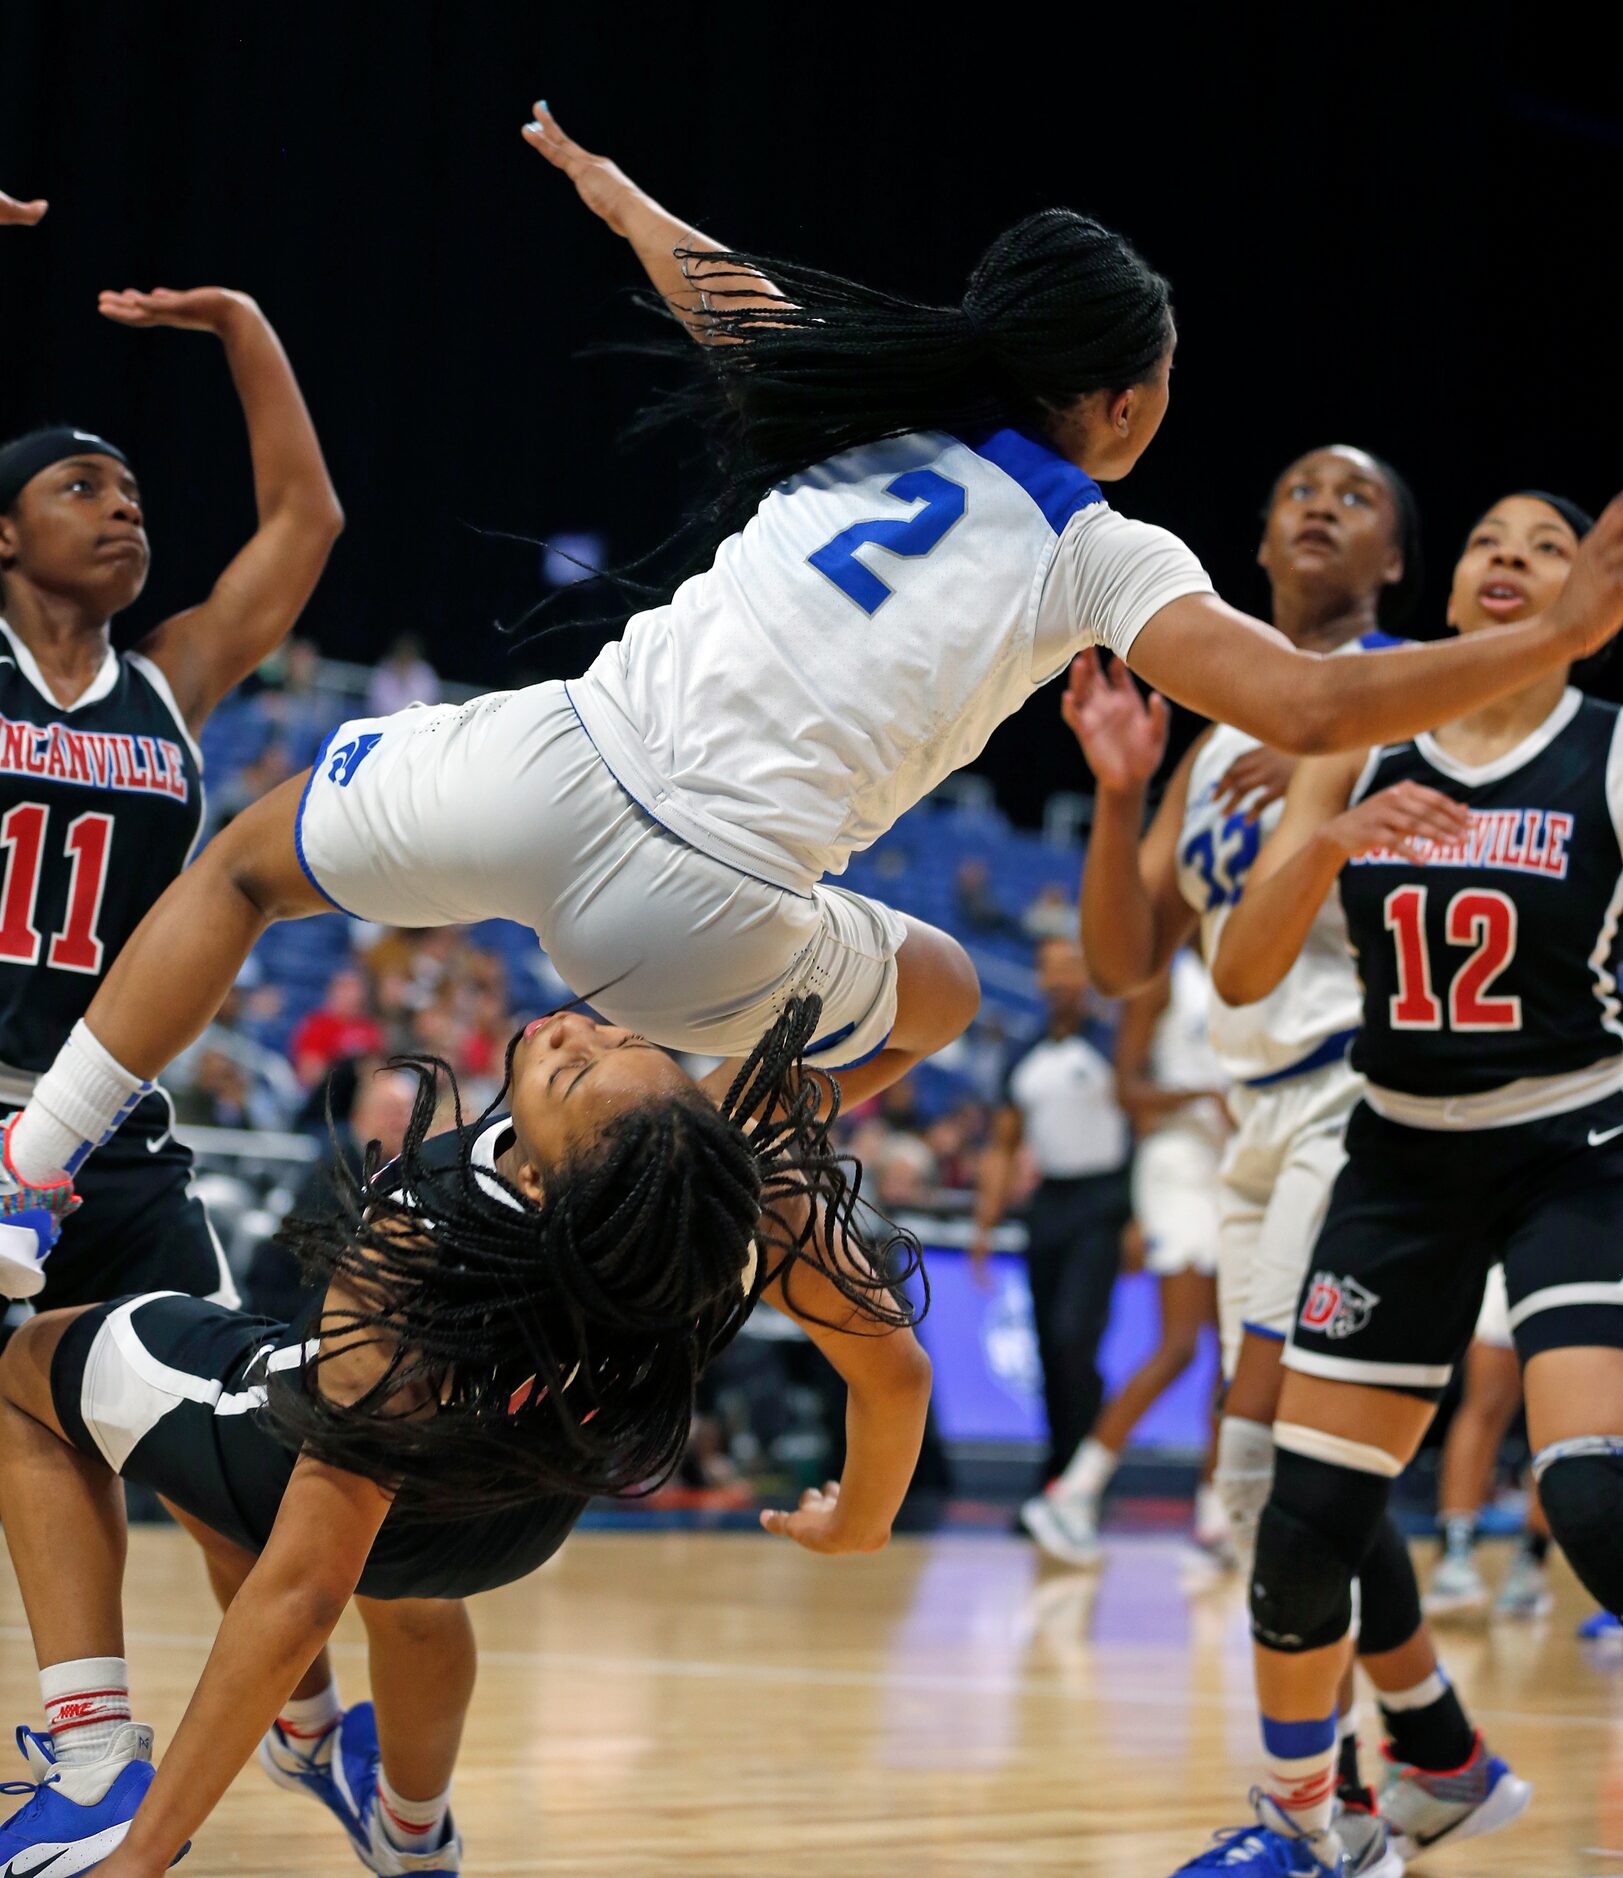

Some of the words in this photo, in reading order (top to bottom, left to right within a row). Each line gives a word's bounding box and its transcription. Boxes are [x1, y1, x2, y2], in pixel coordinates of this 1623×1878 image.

[804, 467, 969, 620] 2
[0, 712, 188, 804] NCANVILLE
[0, 801, 115, 976] 11
[1384, 884, 1522, 1032] 12
[58, 1701, 94, 1719] NIKE
